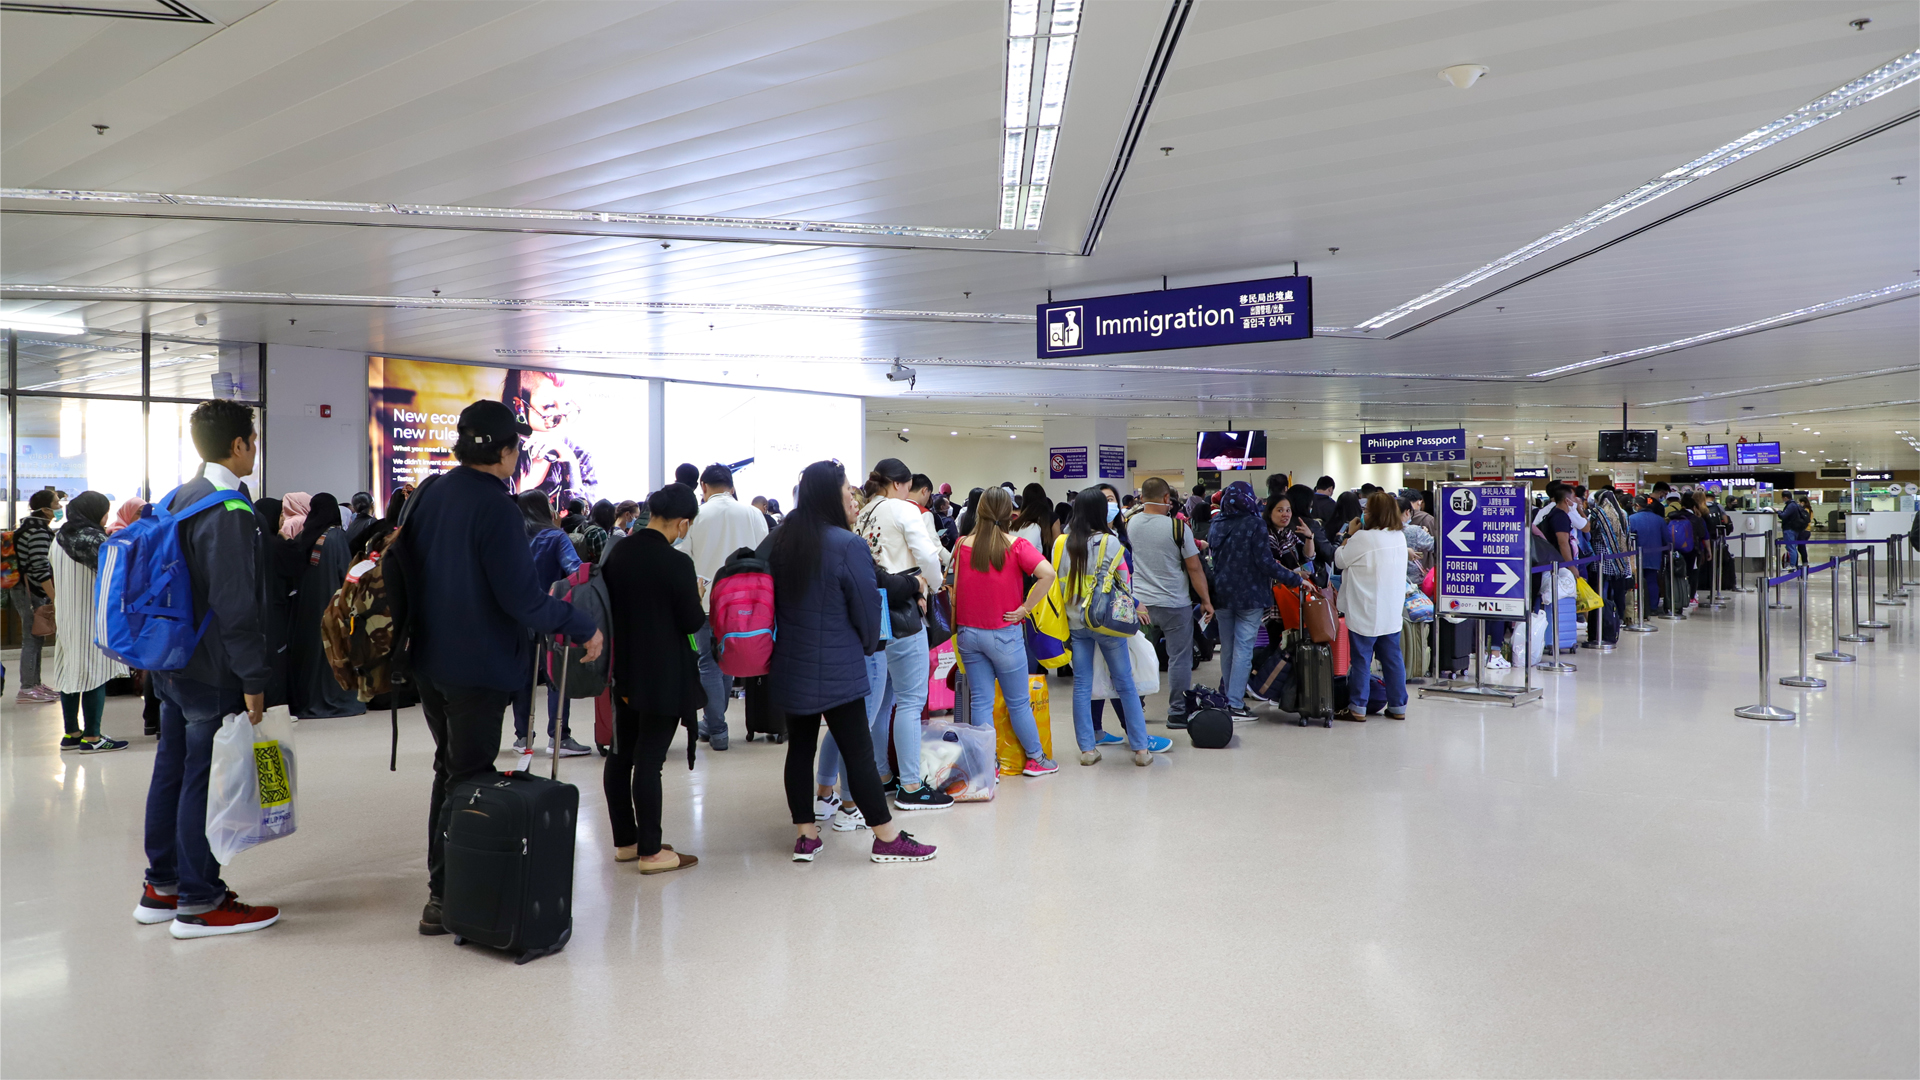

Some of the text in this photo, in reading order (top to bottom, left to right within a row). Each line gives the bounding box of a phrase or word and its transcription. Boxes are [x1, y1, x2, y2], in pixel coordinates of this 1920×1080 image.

[1239, 290, 1294, 304] 移民局出境處
[1096, 305, 1234, 337] Immigration
[1243, 315, 1292, 329] 출입국 심사대
[393, 408, 428, 423] New
[393, 427, 426, 439] new
[1368, 435, 1457, 449] Philippine Passport
[1370, 454, 1376, 463] E
[1402, 450, 1456, 462] GATES
[1482, 521, 1521, 532] PHILIPPINE
[1482, 533, 1518, 543] PASSPORT
[1482, 545, 1510, 555] HOLDER
[1446, 561, 1478, 571] FOREIGN
[1446, 573, 1485, 583] PASSPORT
[1446, 584, 1475, 594] HOLDER
[1478, 601, 1502, 612] MNL
